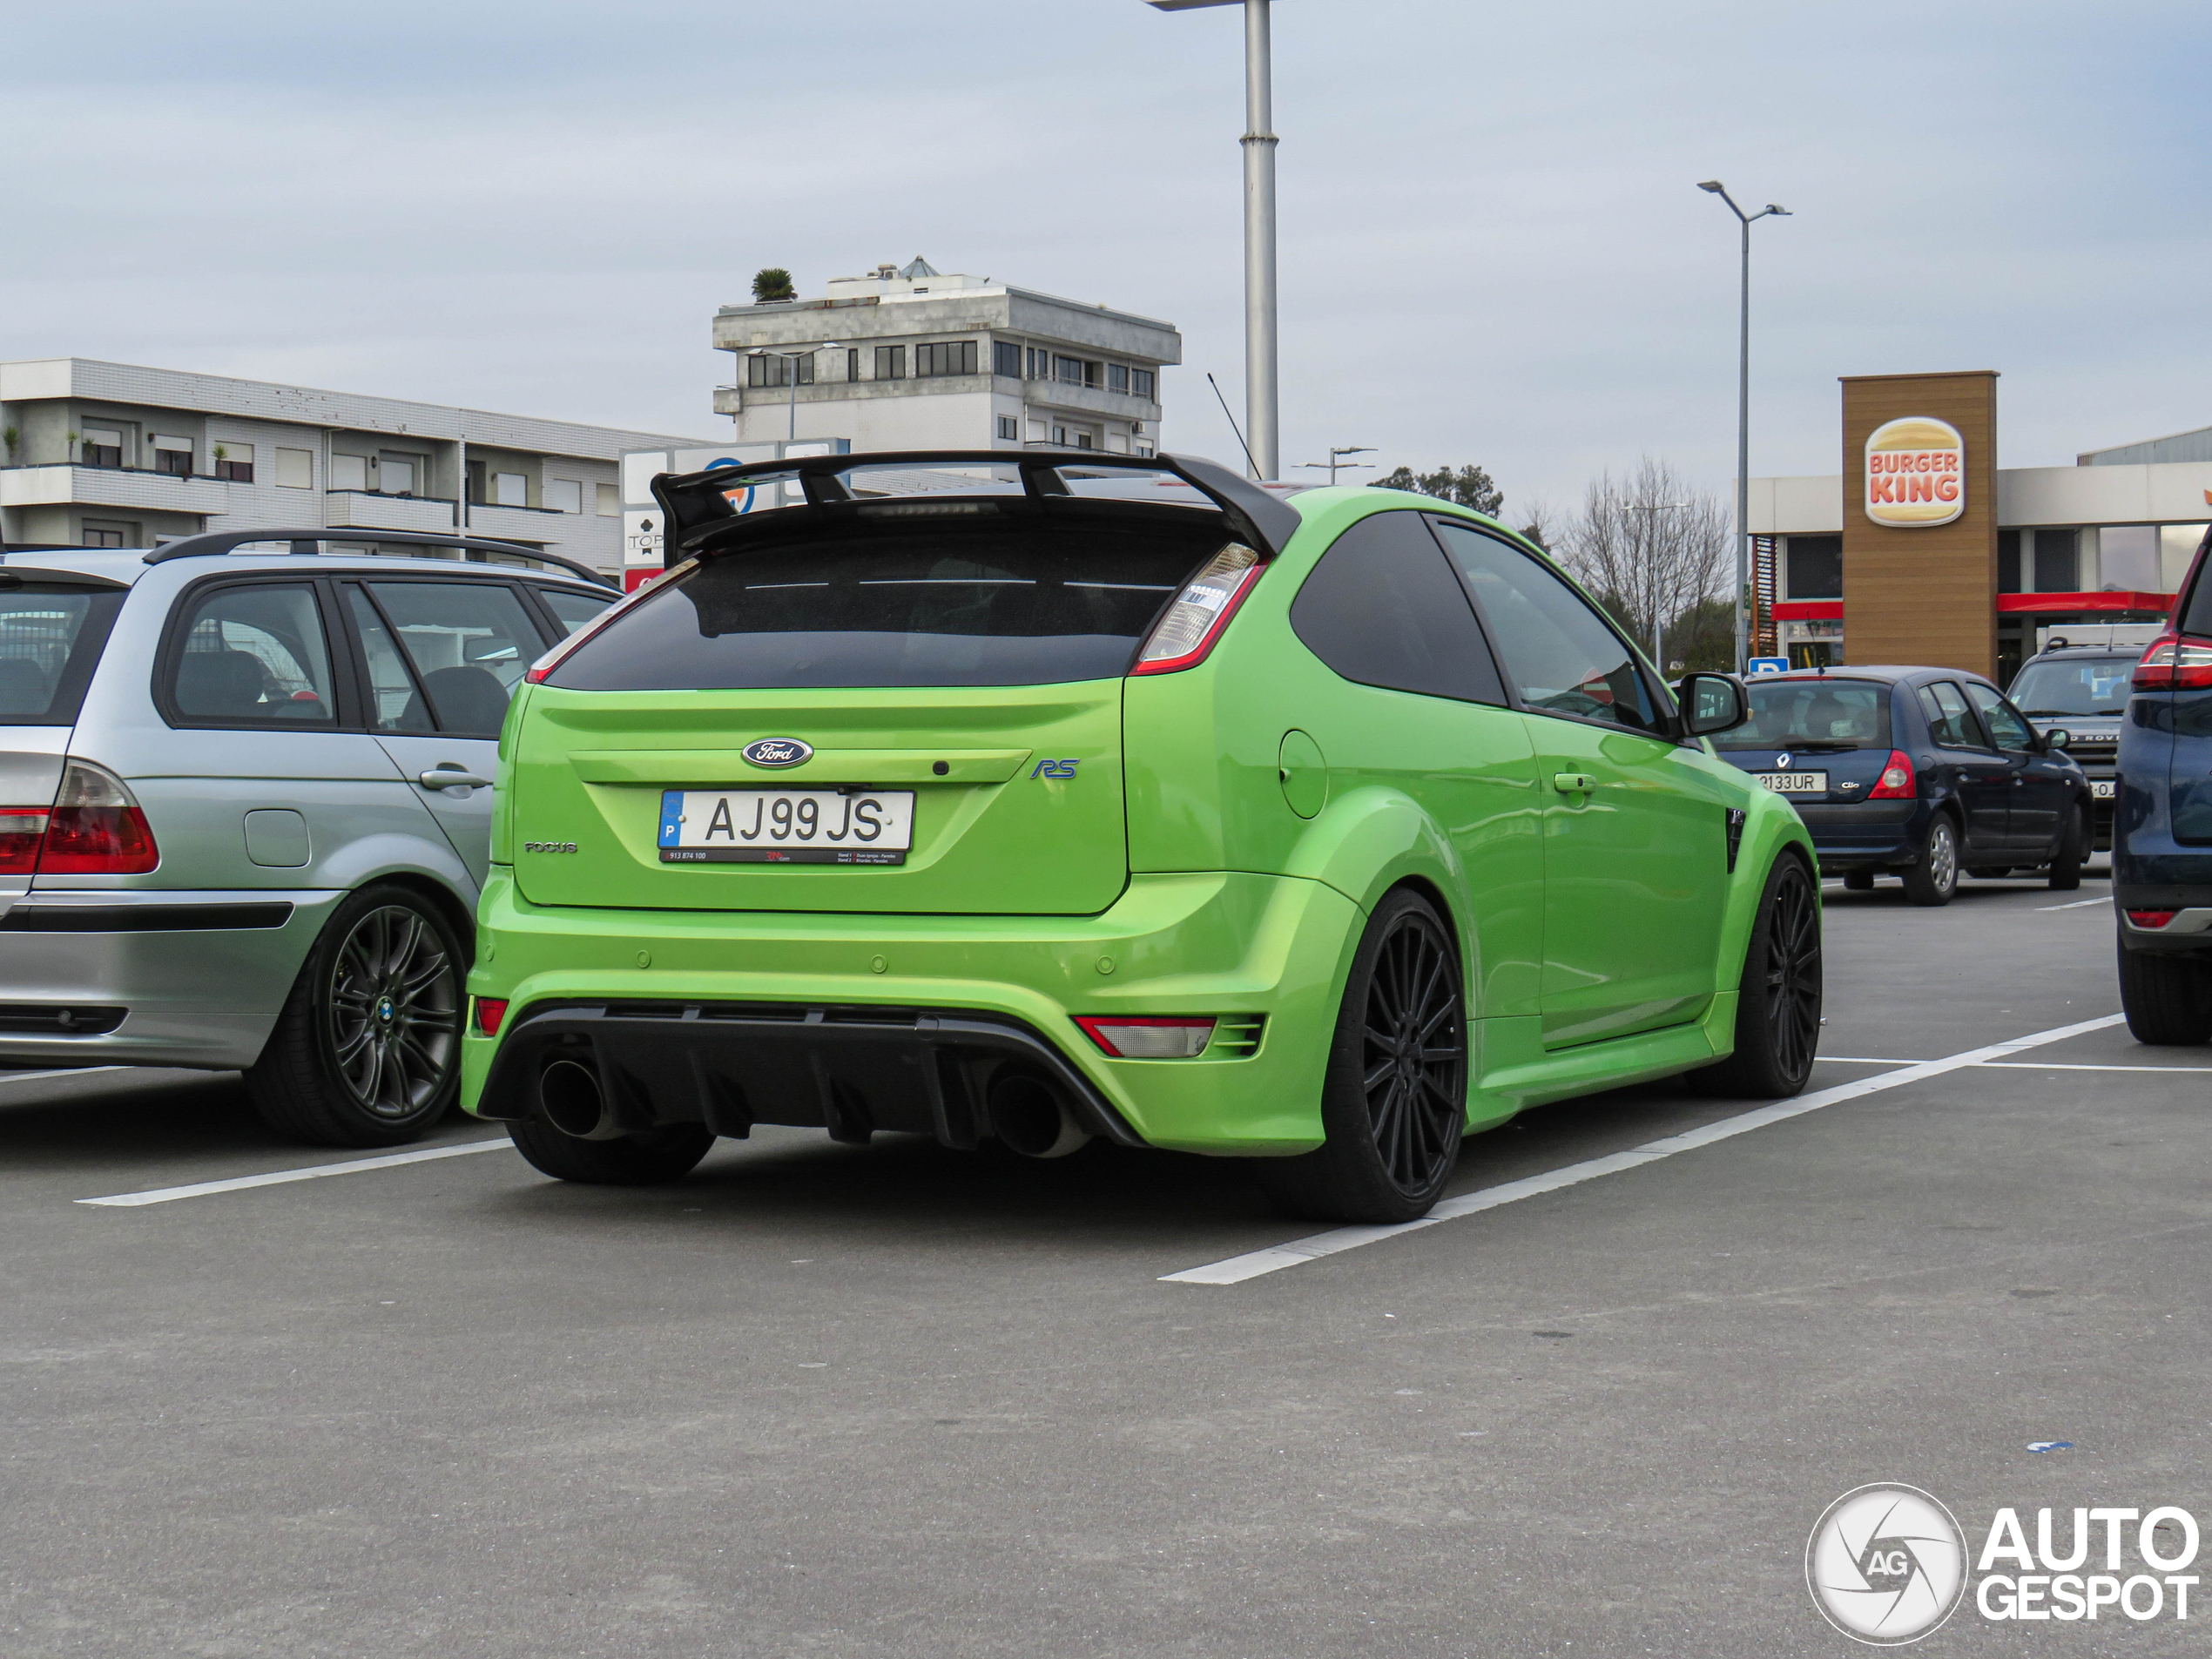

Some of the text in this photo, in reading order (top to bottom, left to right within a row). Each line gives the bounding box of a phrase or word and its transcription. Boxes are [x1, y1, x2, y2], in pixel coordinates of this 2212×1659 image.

[1870, 452, 1959, 474] BURGER
[1870, 474, 1959, 503] KING
[629, 535, 664, 548] TOP
[756, 742, 795, 760] Ford
[1030, 759, 1081, 779] RS
[664, 825, 676, 838] P
[524, 841, 577, 853] FOCUS
